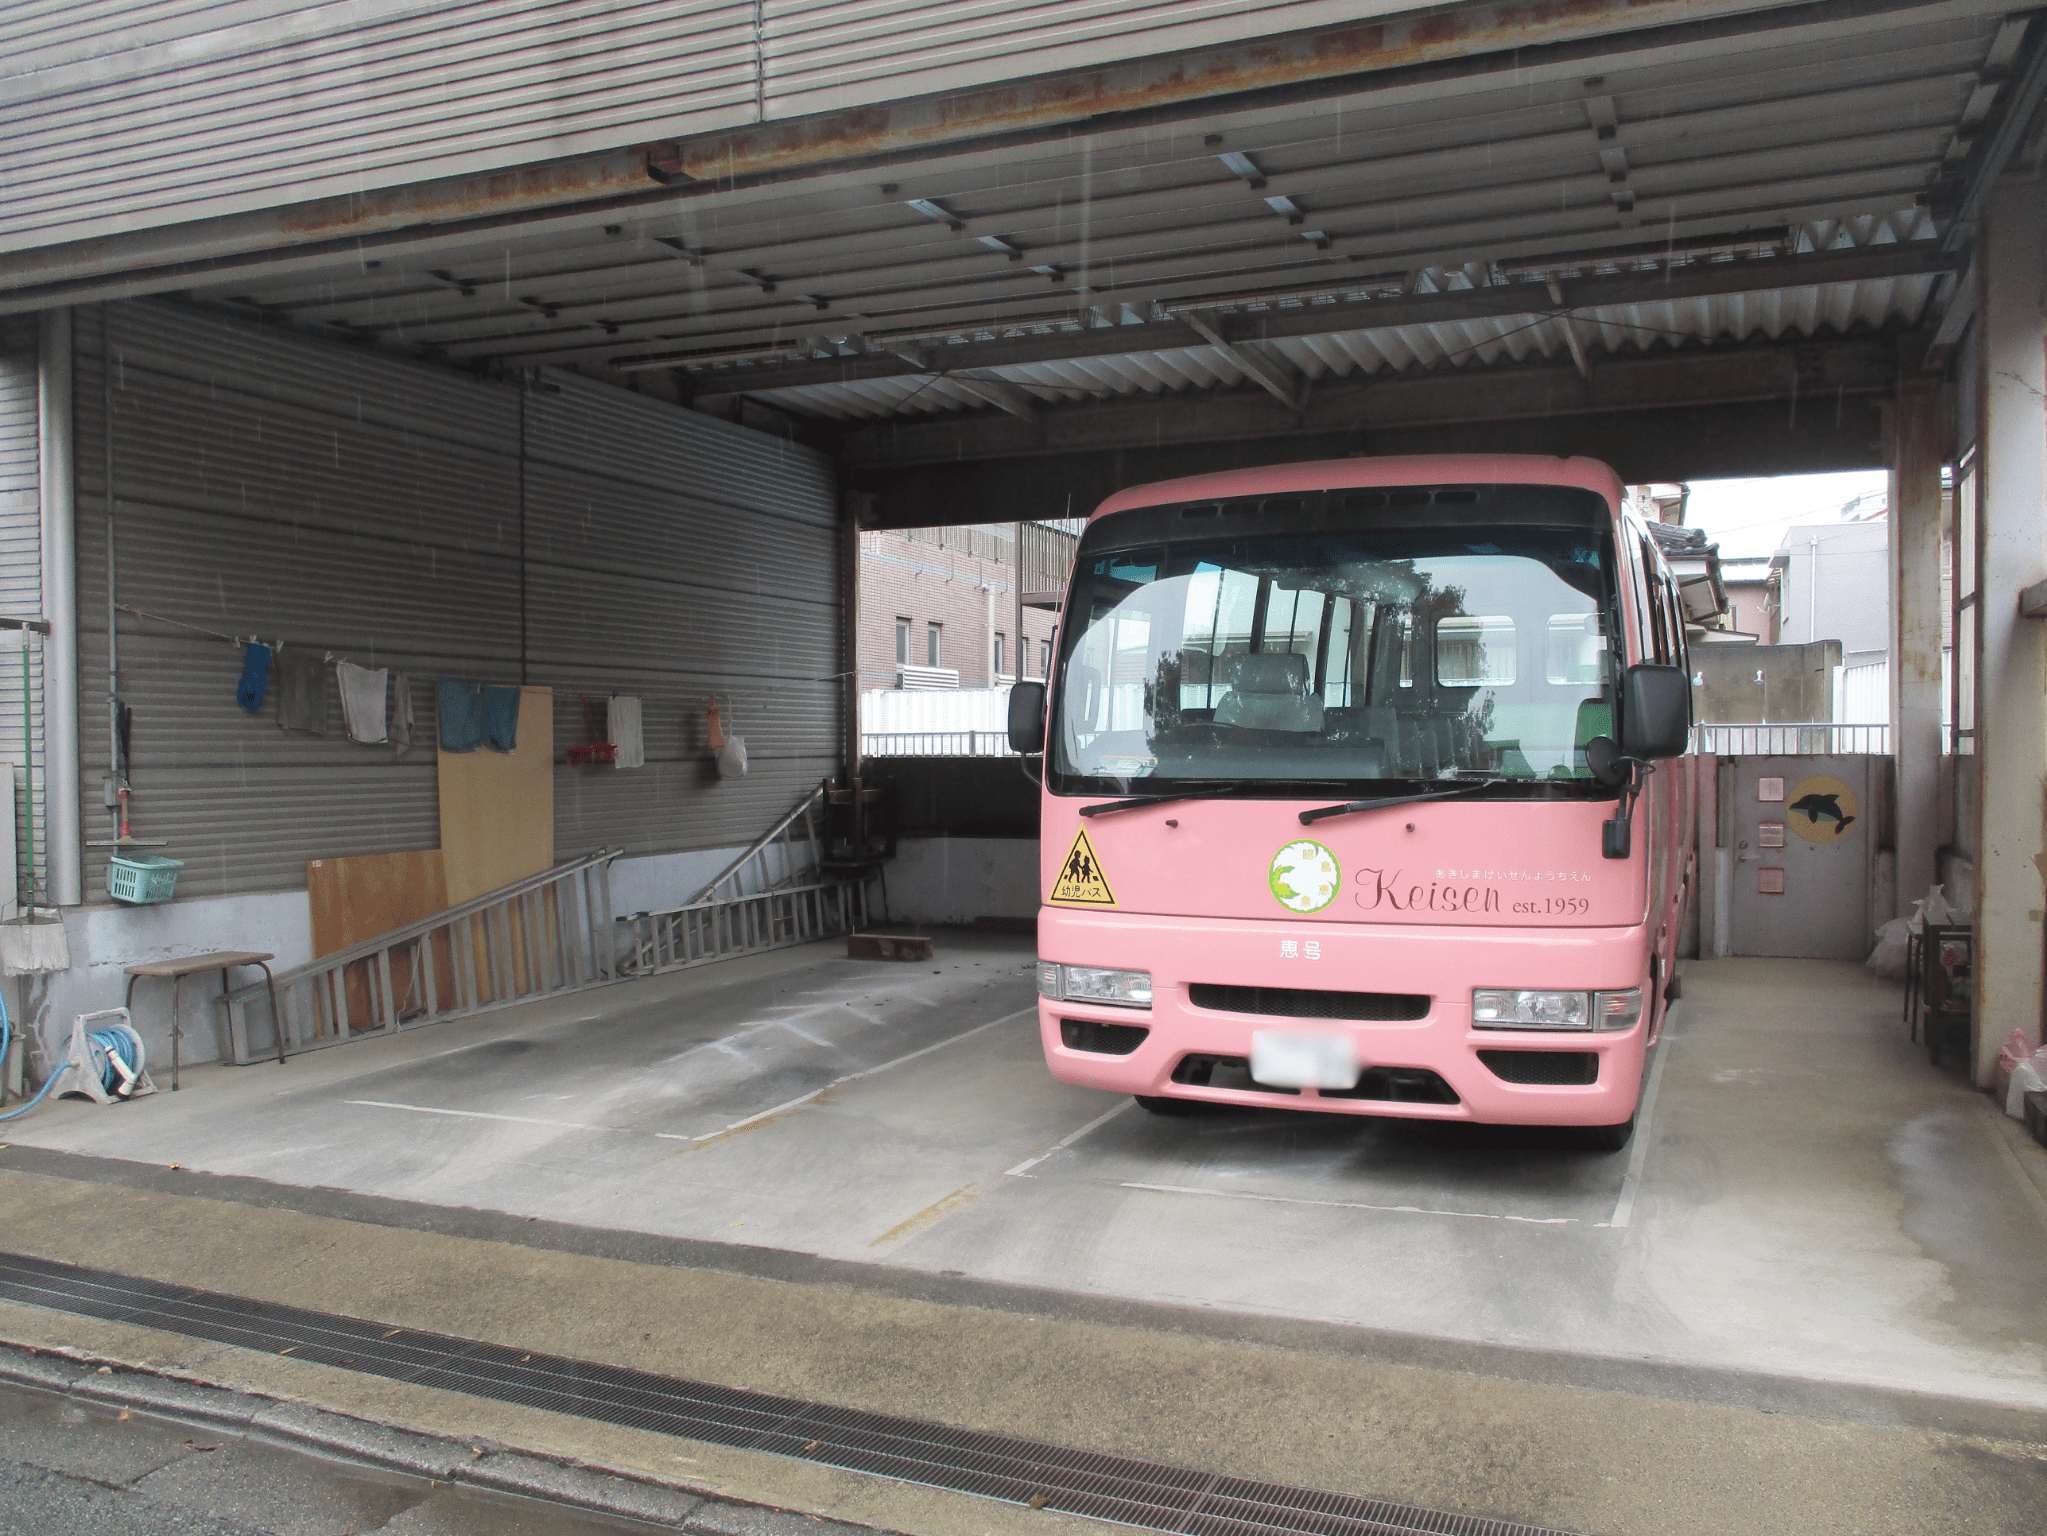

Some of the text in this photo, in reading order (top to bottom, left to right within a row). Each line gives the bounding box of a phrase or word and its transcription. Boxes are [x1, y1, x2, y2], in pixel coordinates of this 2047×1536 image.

[1435, 869, 1591, 882] あきしまけいせんようちえん
[1061, 885, 1102, 898] 幼児バス
[1355, 868, 1590, 915] Keisen est.1959
[1280, 940, 1321, 960] 恵号
